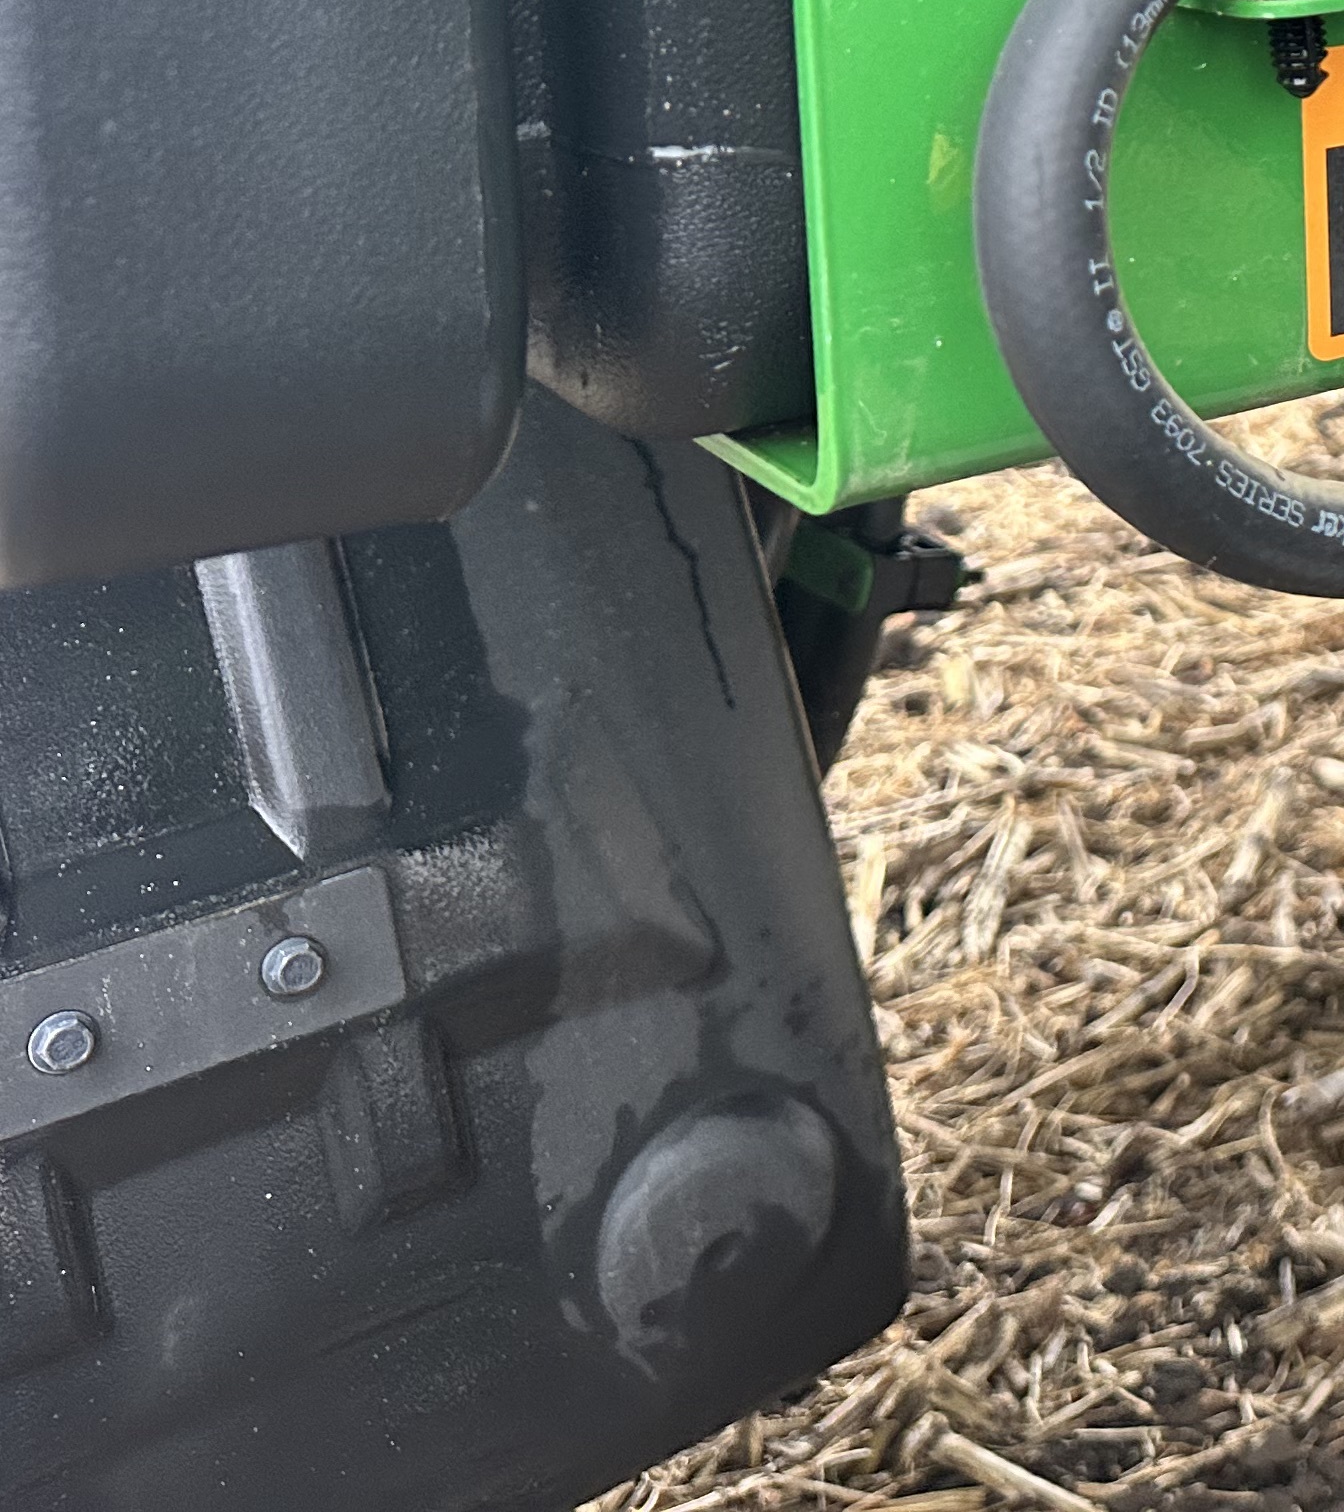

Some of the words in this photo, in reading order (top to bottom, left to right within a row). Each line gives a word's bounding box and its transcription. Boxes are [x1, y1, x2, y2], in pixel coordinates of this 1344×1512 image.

[1092, 88, 1117, 128] ID
[1085, 149, 1106, 211] 1/2
[1151, 398, 1206, 466] 7093
[1215, 460, 1306, 527] SERIES
